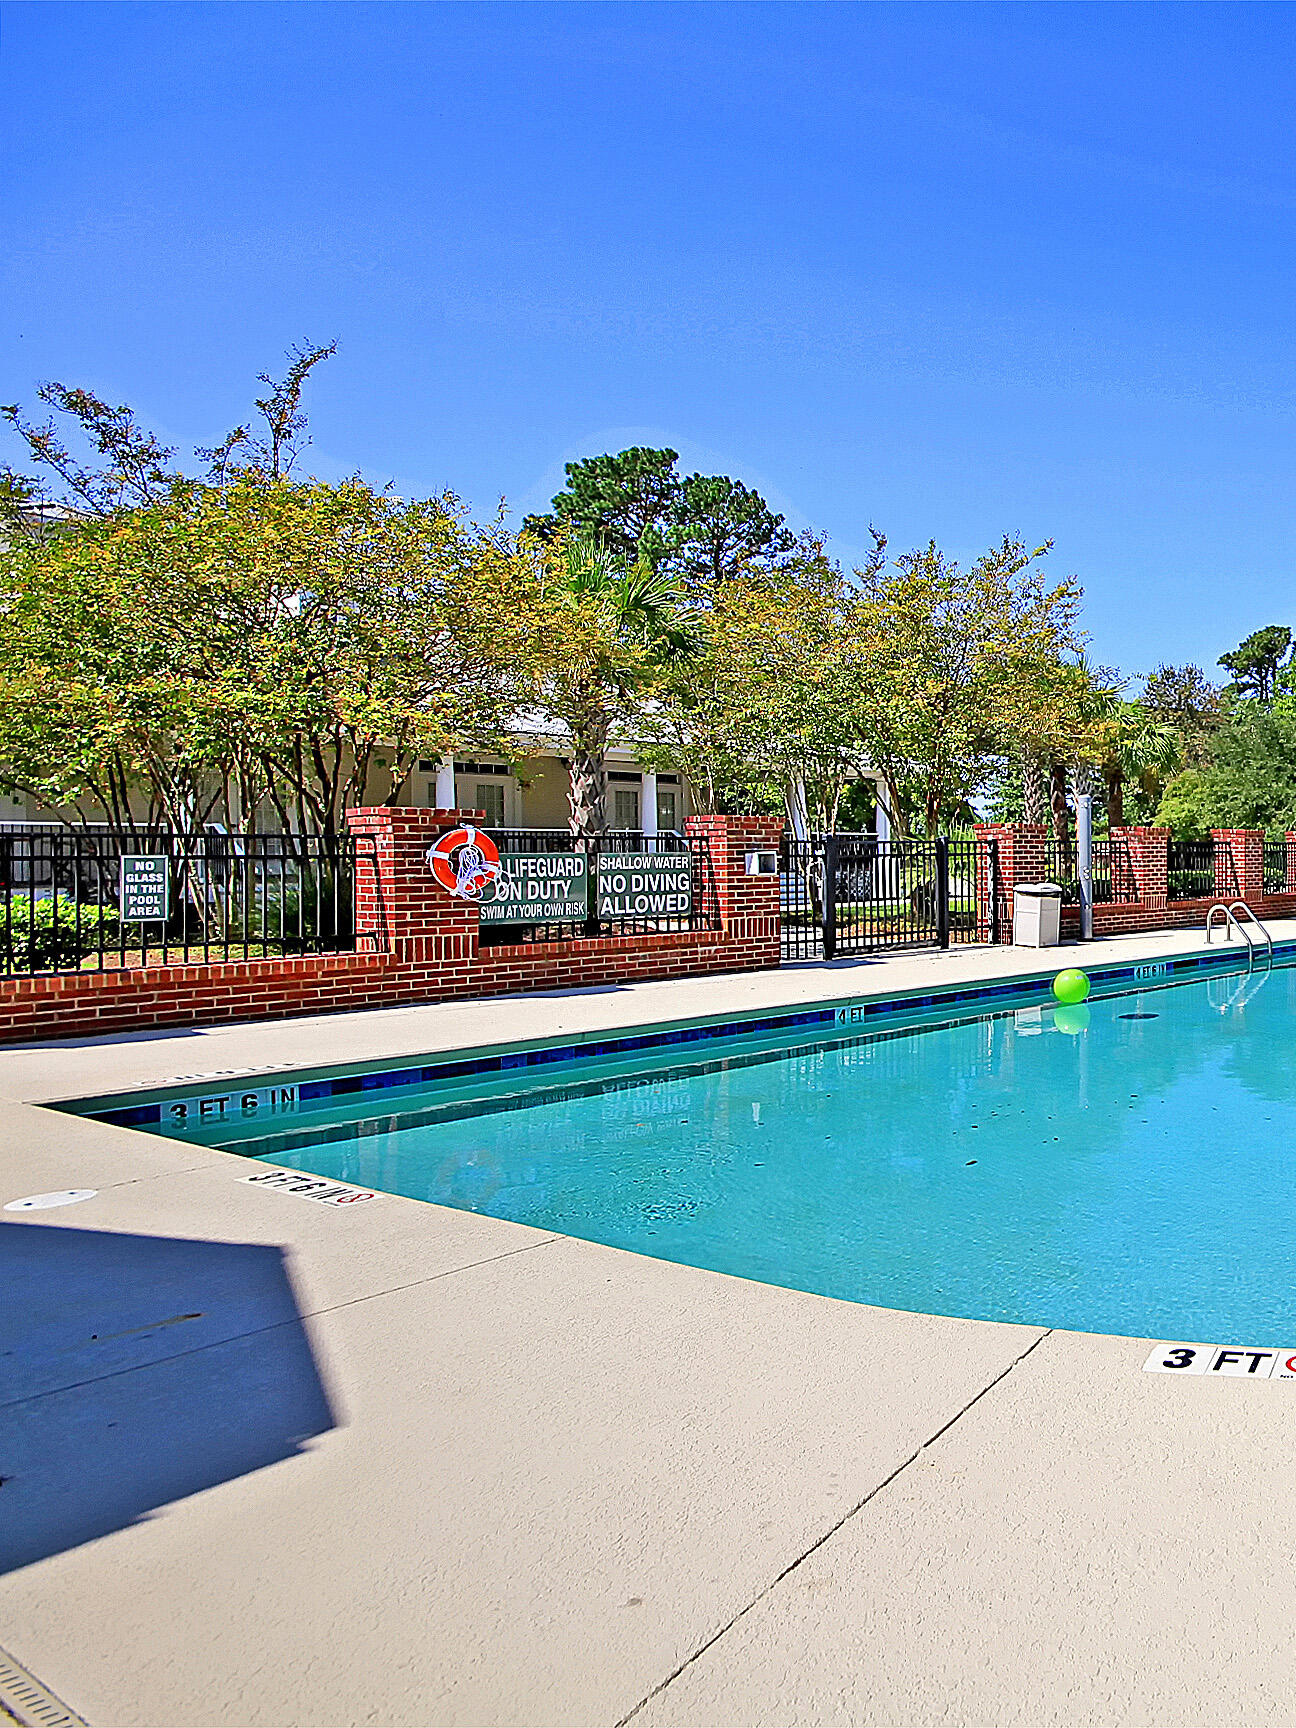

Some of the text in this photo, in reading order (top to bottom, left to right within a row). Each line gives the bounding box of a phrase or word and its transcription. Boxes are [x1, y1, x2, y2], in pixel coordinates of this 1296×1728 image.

[134, 861, 155, 871] NO
[507, 857, 584, 878] LIFEGUARD
[600, 856, 689, 870] SHALLOW WATER
[126, 873, 164, 883] GLASS
[600, 873, 690, 893] NO DIVING
[125, 884, 165, 894] IN THE
[497, 880, 572, 901] ON DUTY
[129, 895, 161, 905] POOL
[601, 893, 689, 915] ALLOWED
[128, 906, 161, 916] AREA
[480, 901, 585, 920] SWIM AT YOUR OWN RISK
[170, 1103, 188, 1118] 3
[241, 1093, 258, 1109] 6
[270, 1087, 295, 1105] IN
[1162, 1348, 1273, 1374] 3 FT
